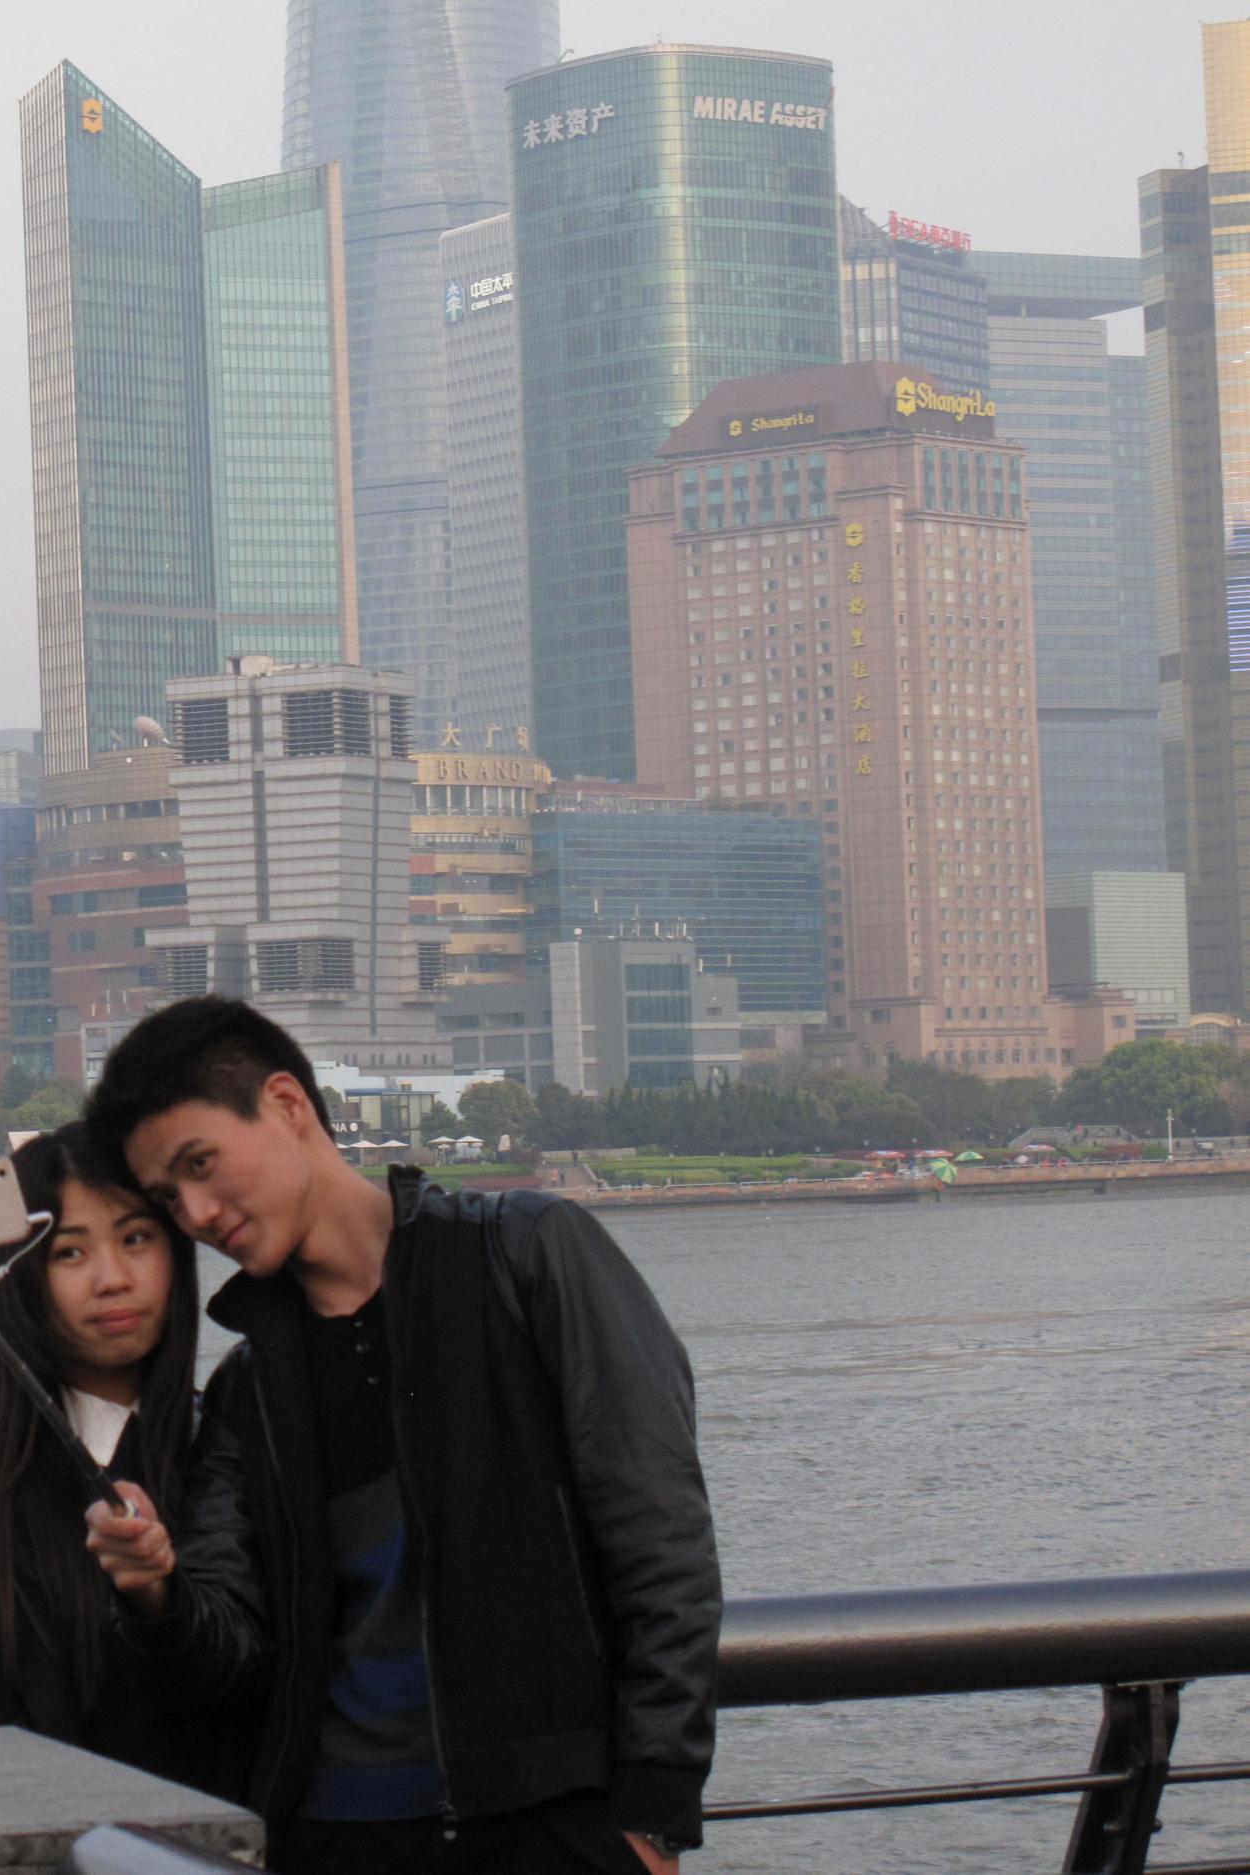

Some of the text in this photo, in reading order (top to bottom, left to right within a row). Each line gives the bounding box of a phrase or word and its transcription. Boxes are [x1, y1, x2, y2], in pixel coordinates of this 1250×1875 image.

[523, 102, 615, 149] 未来资产
[693, 95, 827, 131] MIRAE ASSET
[470, 272, 514, 298] 中国太平
[916, 382, 996, 422] Shangri-La
[437, 759, 522, 782] BRAND
